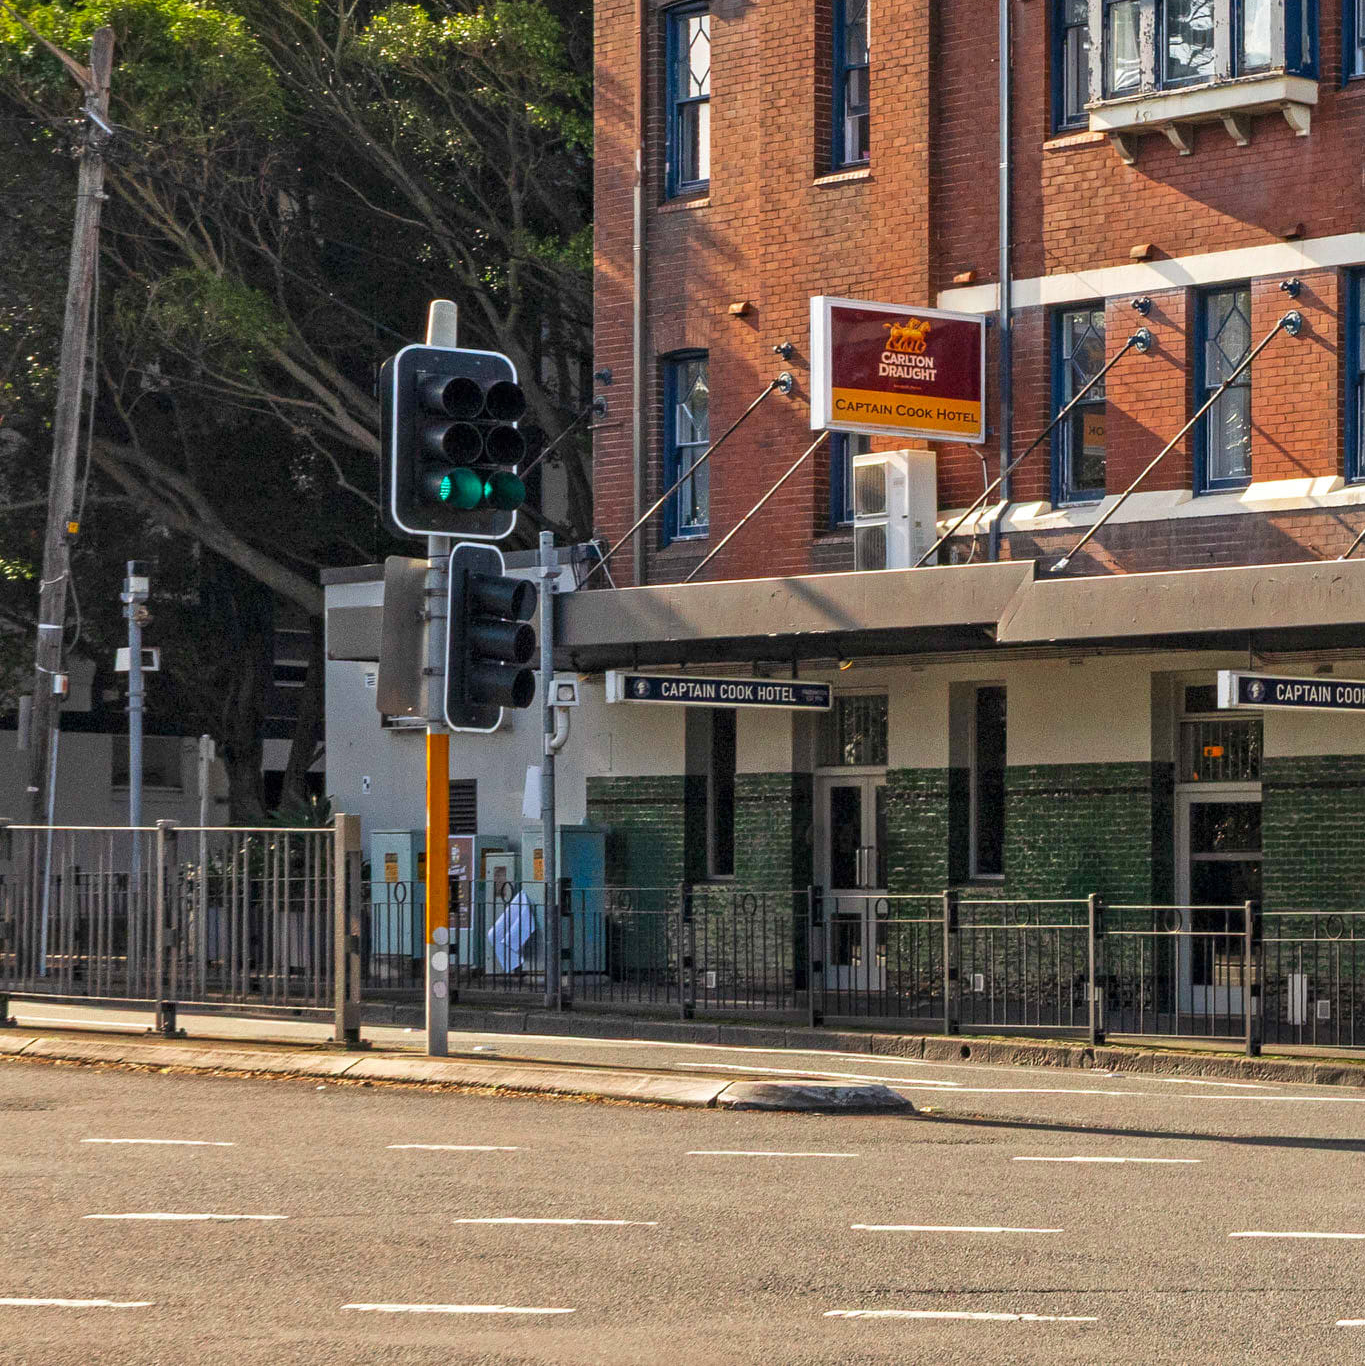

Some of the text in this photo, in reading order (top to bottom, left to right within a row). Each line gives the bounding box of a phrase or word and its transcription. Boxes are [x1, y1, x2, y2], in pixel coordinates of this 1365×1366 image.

[881, 351, 934, 368] CARLTON
[878, 362, 937, 382] DRAUGHT
[835, 398, 979, 423] CAPTAIN COOK HOTEL
[661, 681, 715, 699] CAPTAIN
[719, 684, 754, 700] COOK
[757, 686, 797, 702] HOTEL
[1276, 683, 1331, 703] CAPTAIN
